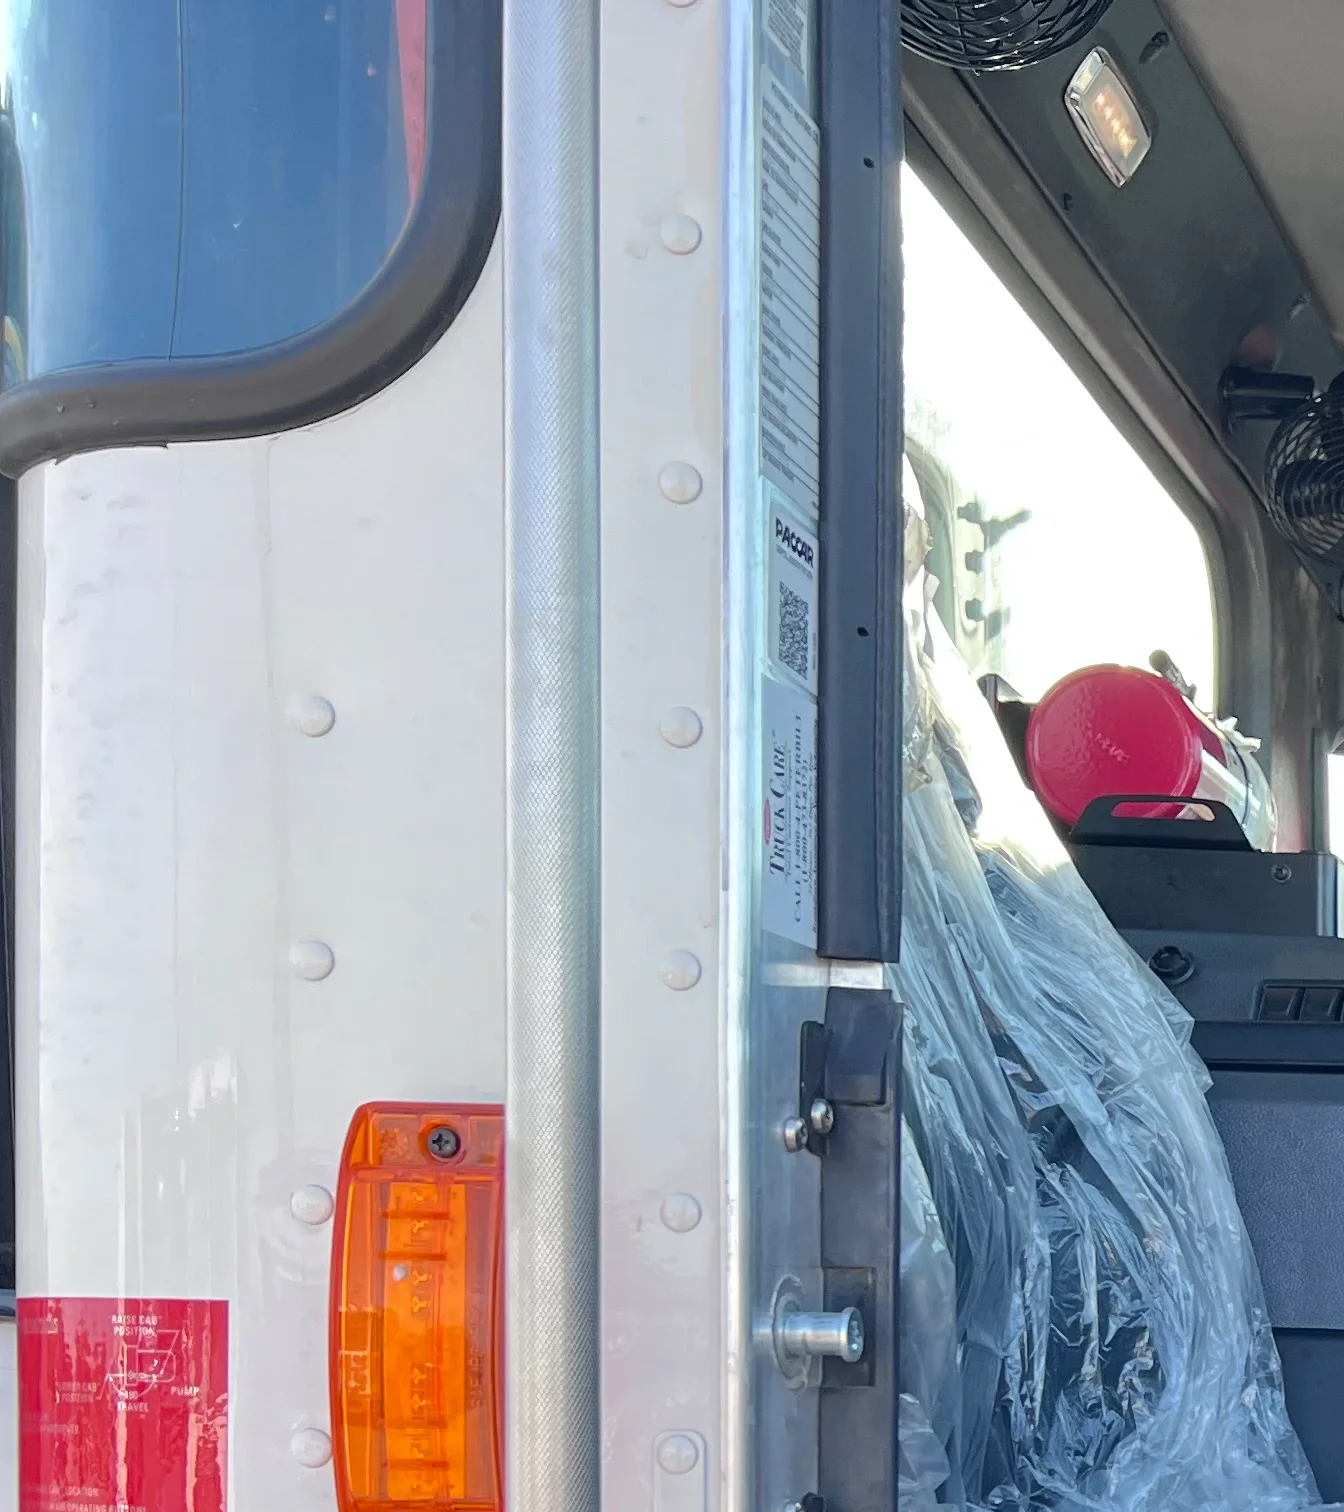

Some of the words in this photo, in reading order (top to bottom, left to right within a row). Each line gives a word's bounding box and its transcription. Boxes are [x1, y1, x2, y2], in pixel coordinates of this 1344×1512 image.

[775, 515, 815, 569] PACCAR
[769, 743, 785, 800] CARE
[769, 807, 785, 876] TRUCK
[171, 1386, 200, 1397] PUMP
